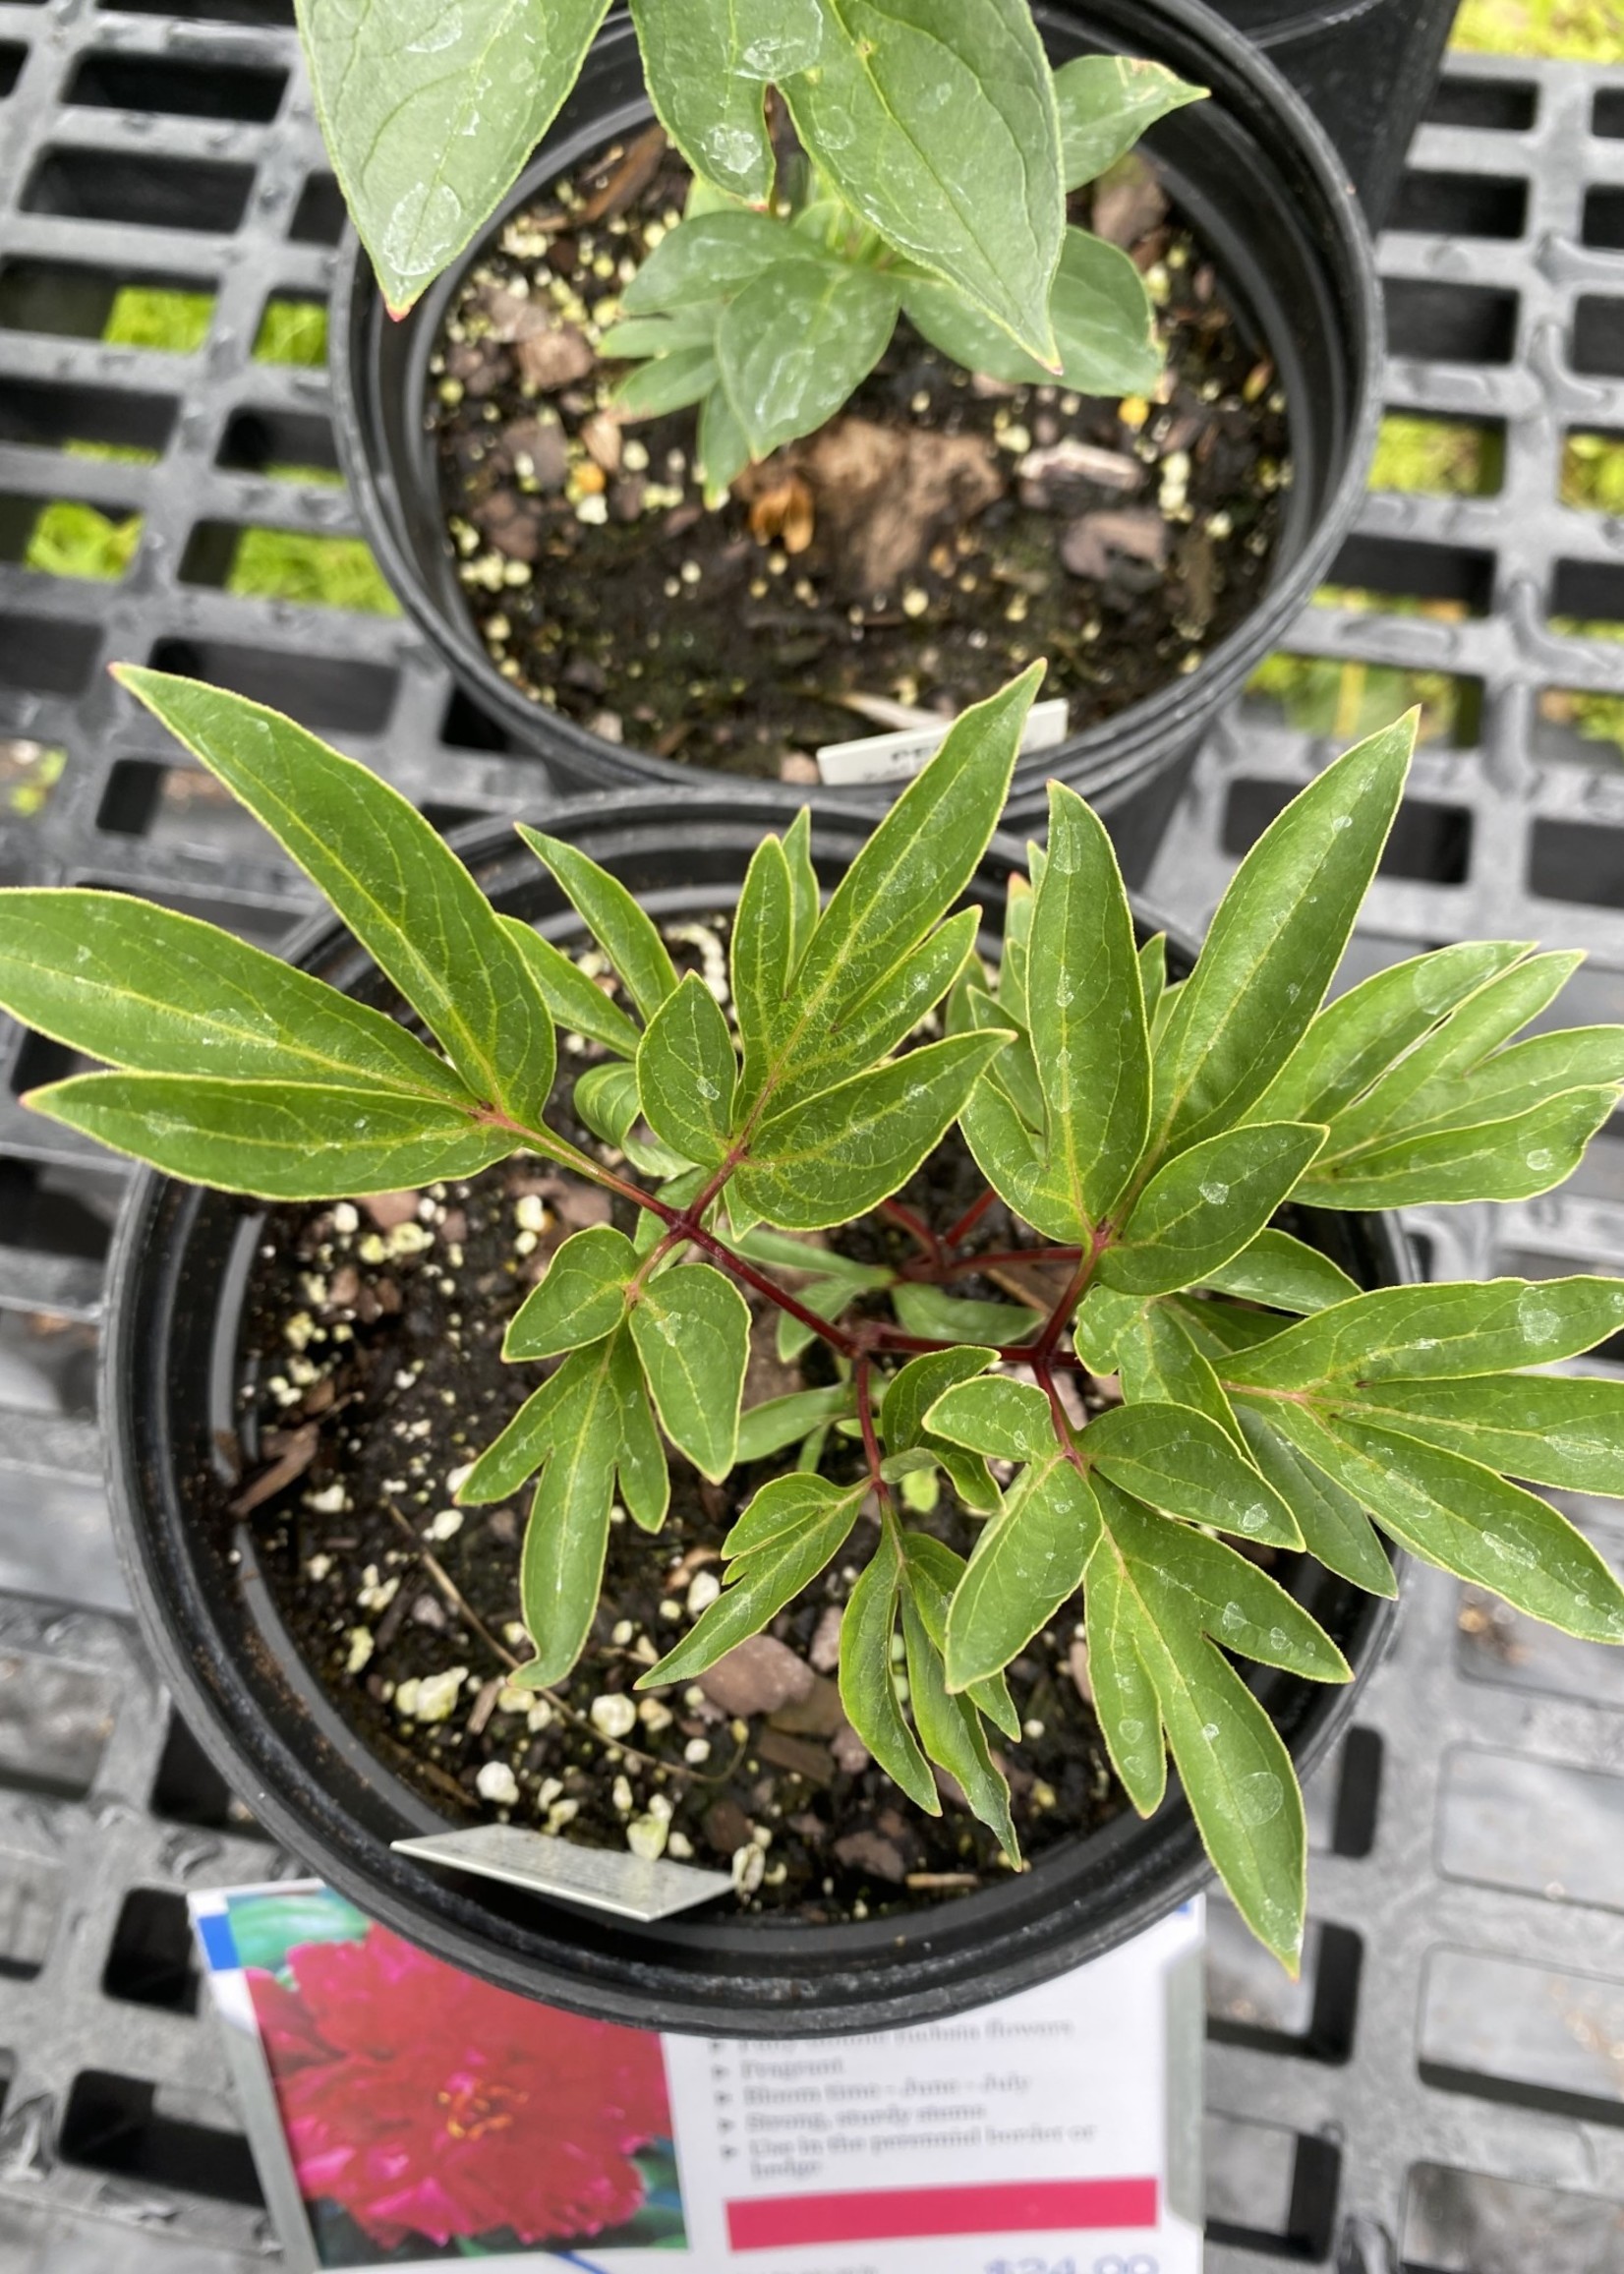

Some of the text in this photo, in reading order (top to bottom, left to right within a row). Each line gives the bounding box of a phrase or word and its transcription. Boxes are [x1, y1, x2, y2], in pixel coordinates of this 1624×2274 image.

[740, 2057, 842, 2079] Fragrant
[744, 2084, 823, 2104] Bloom
[824, 2081, 881, 2099] time
[902, 2076, 960, 2097] June
[981, 2070, 1031, 2094] July
[797, 2135, 824, 2155] in
[827, 2132, 867, 2154] the
[985, 2123, 1064, 2143] border
